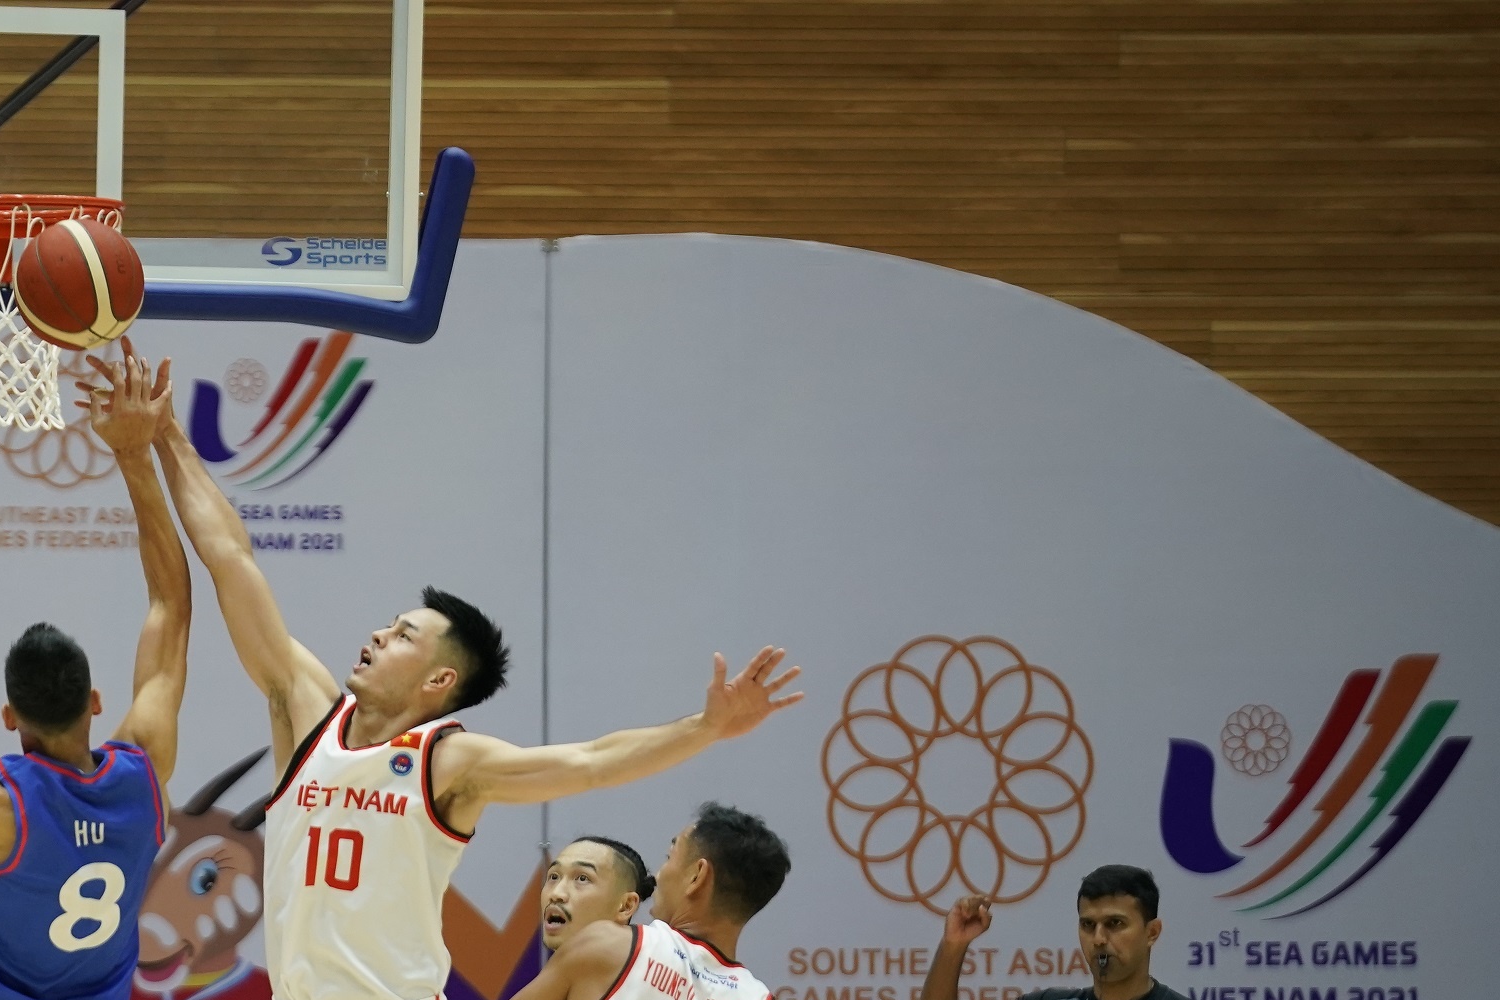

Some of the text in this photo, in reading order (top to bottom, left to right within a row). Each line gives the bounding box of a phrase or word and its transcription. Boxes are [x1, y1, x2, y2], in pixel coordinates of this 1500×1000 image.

[307, 252, 386, 267] Sports
[239, 504, 343, 521] SEA GAMES
[300, 532, 344, 551] 2021
[343, 787, 408, 817] NAM
[74, 819, 105, 847] HU
[305, 825, 365, 892] 10
[48, 861, 126, 953] 8
[787, 947, 1091, 977] SOUTHEST ASIA
[1245, 940, 1304, 966] SEA
[1311, 940, 1418, 966] GAMES
